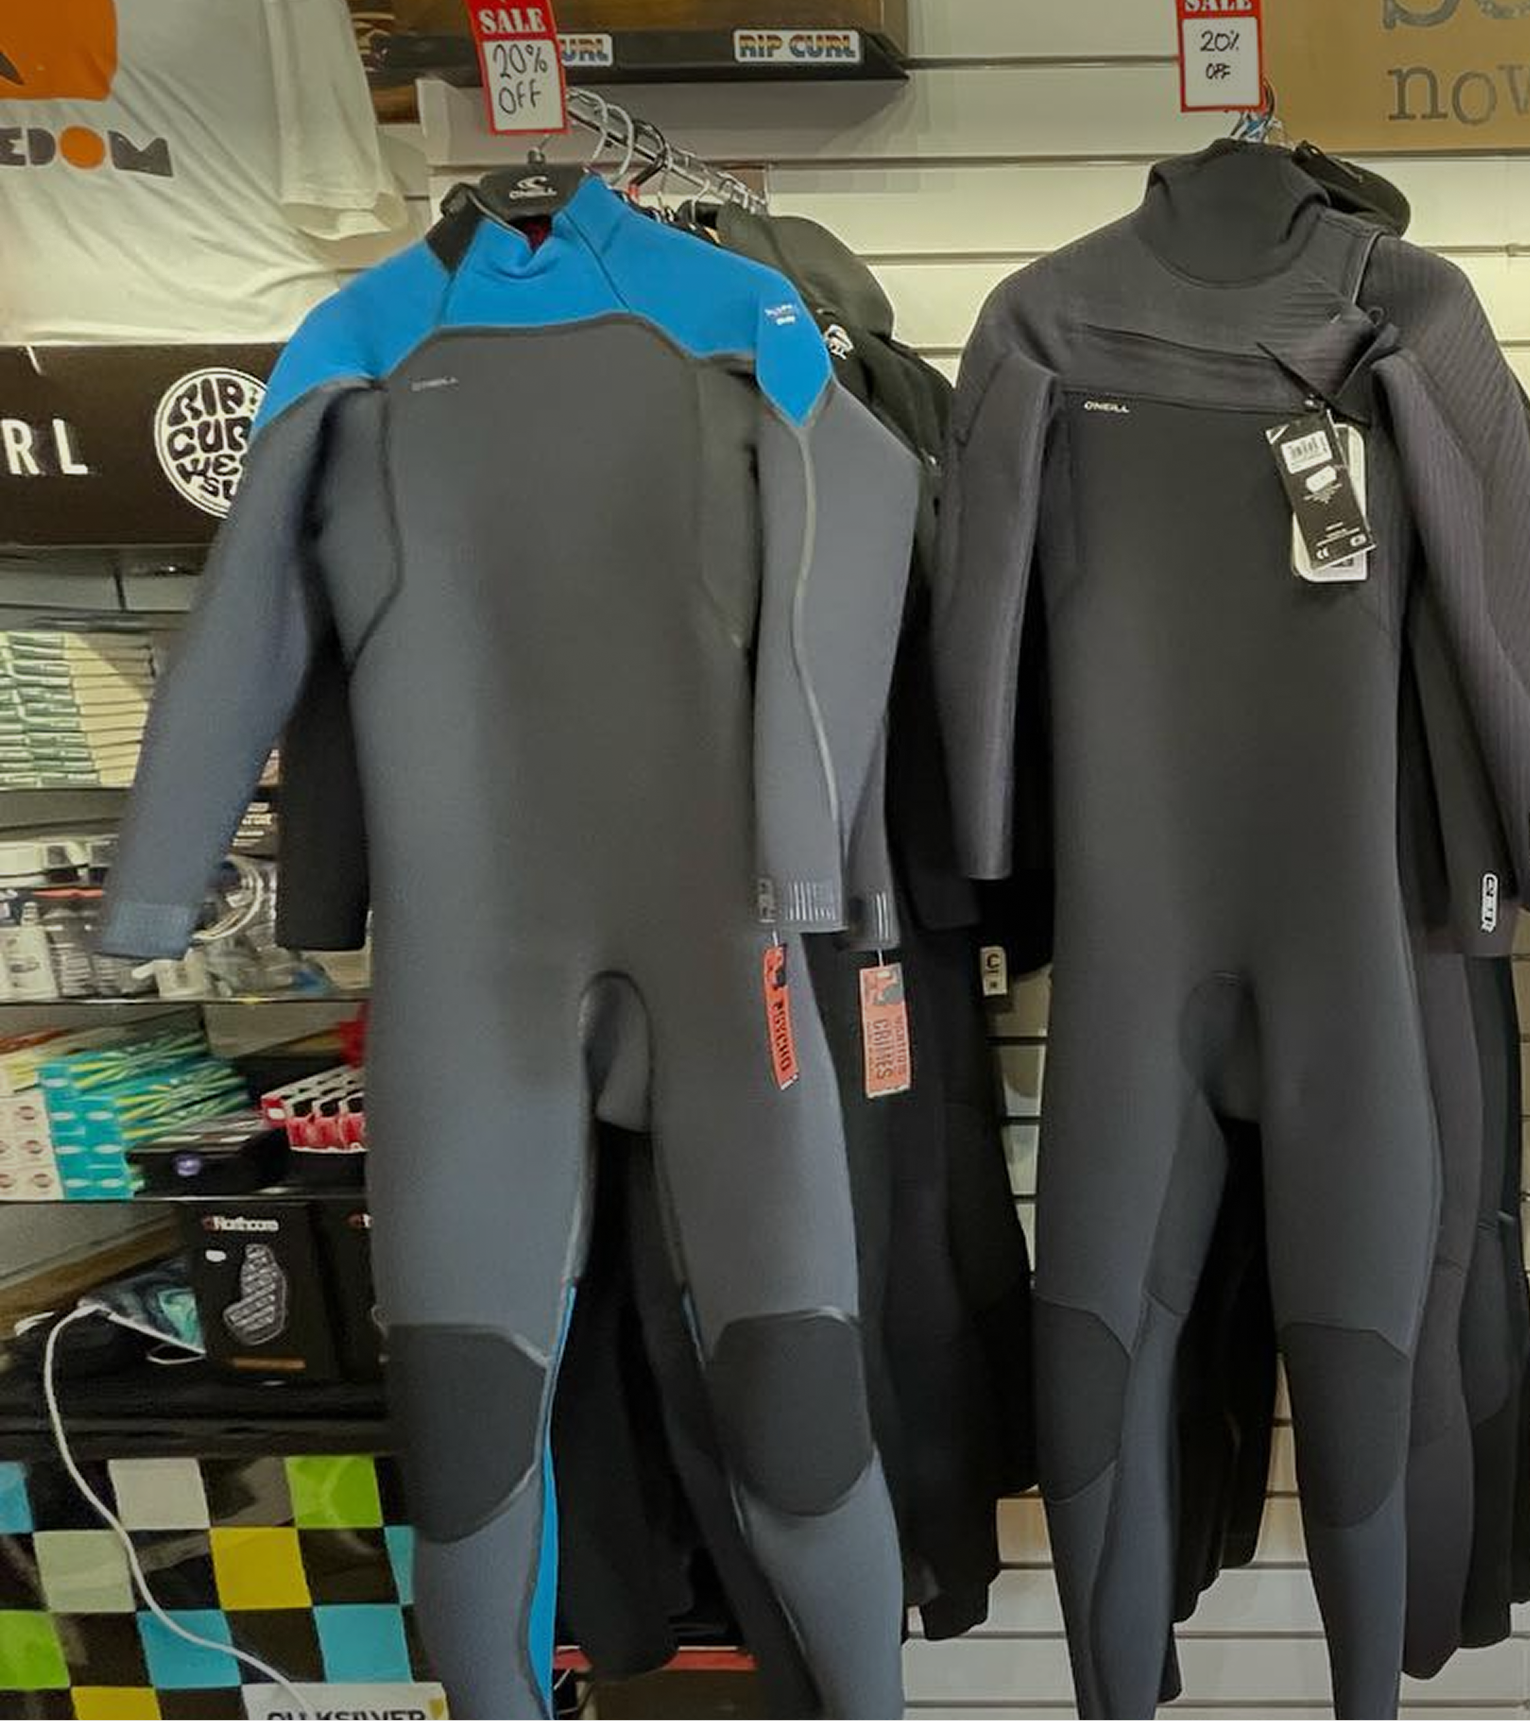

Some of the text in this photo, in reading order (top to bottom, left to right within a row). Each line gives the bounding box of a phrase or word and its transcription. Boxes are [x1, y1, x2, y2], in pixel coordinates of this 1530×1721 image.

[479, 7, 546, 34] SALE
[560, 37, 609, 62] URL
[739, 34, 856, 58] RIP CURL
[1200, 29, 1240, 52] 20%
[493, 43, 548, 79] 20%
[167, 377, 245, 427] RIP
[167, 416, 252, 463] CUR
[175, 453, 241, 484] WE
